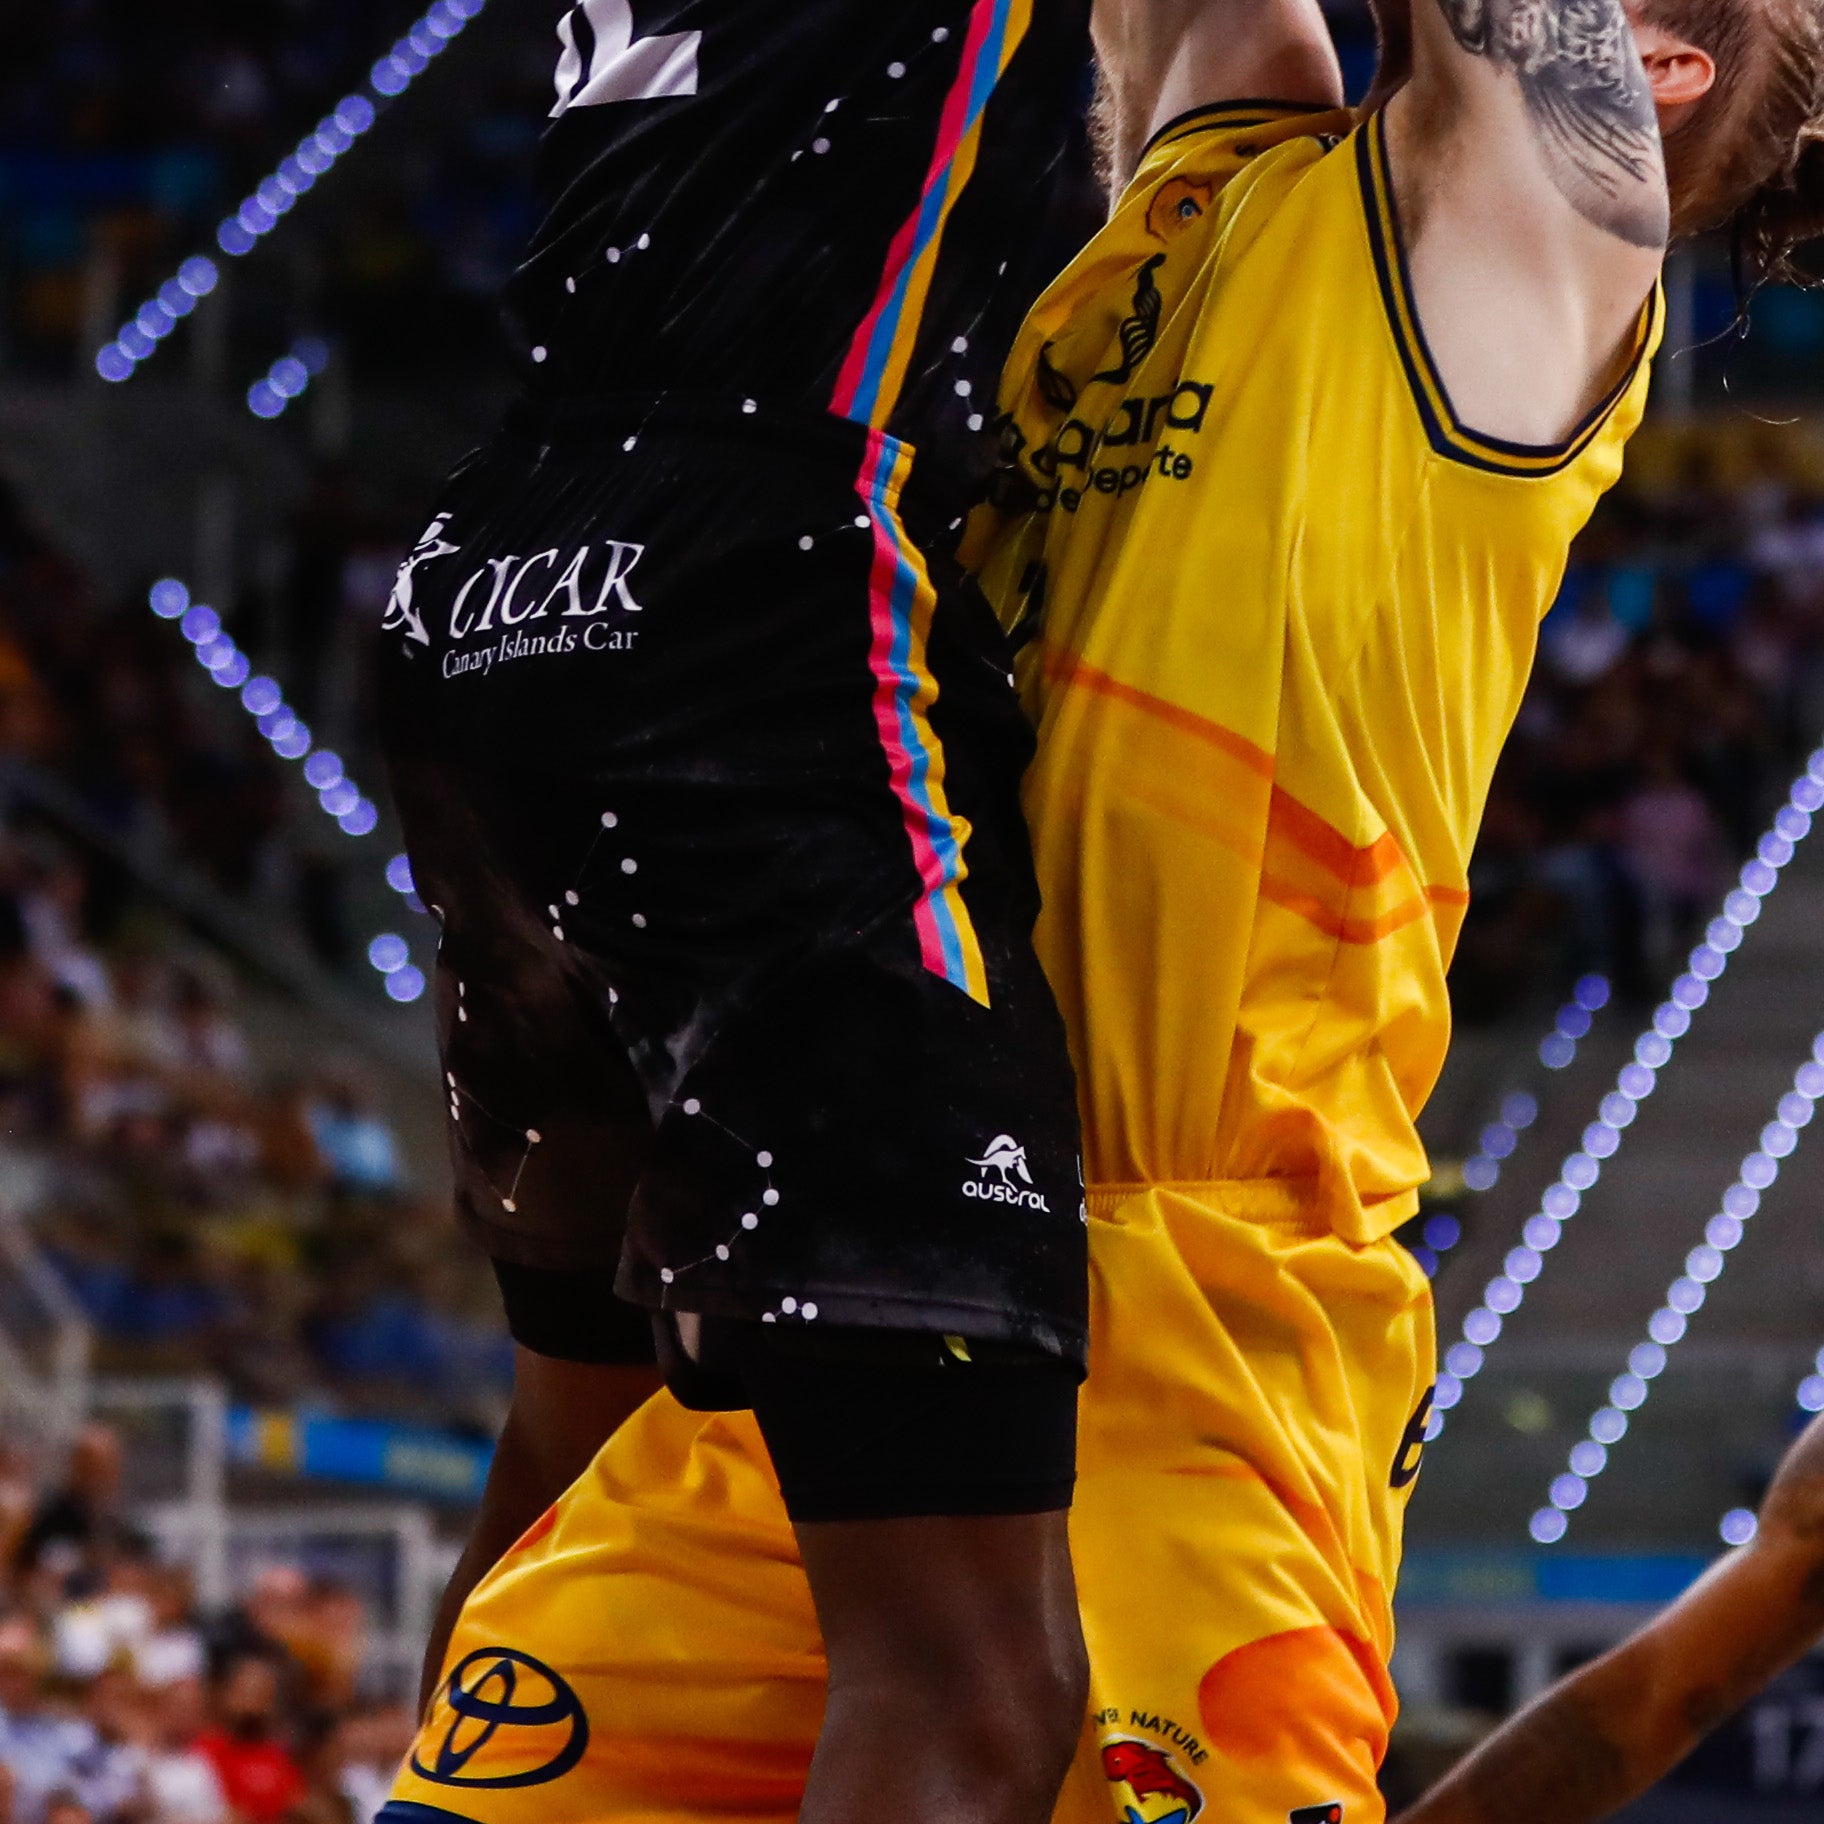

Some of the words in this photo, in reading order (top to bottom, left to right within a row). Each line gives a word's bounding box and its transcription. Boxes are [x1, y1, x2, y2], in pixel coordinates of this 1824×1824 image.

[449, 540, 645, 640] CICAR
[442, 643, 499, 679] Canary
[497, 625, 578, 663] Islands
[583, 622, 639, 651] Car
[961, 1180, 1051, 1213] austral
[1130, 1710, 1210, 1766] NATURE
